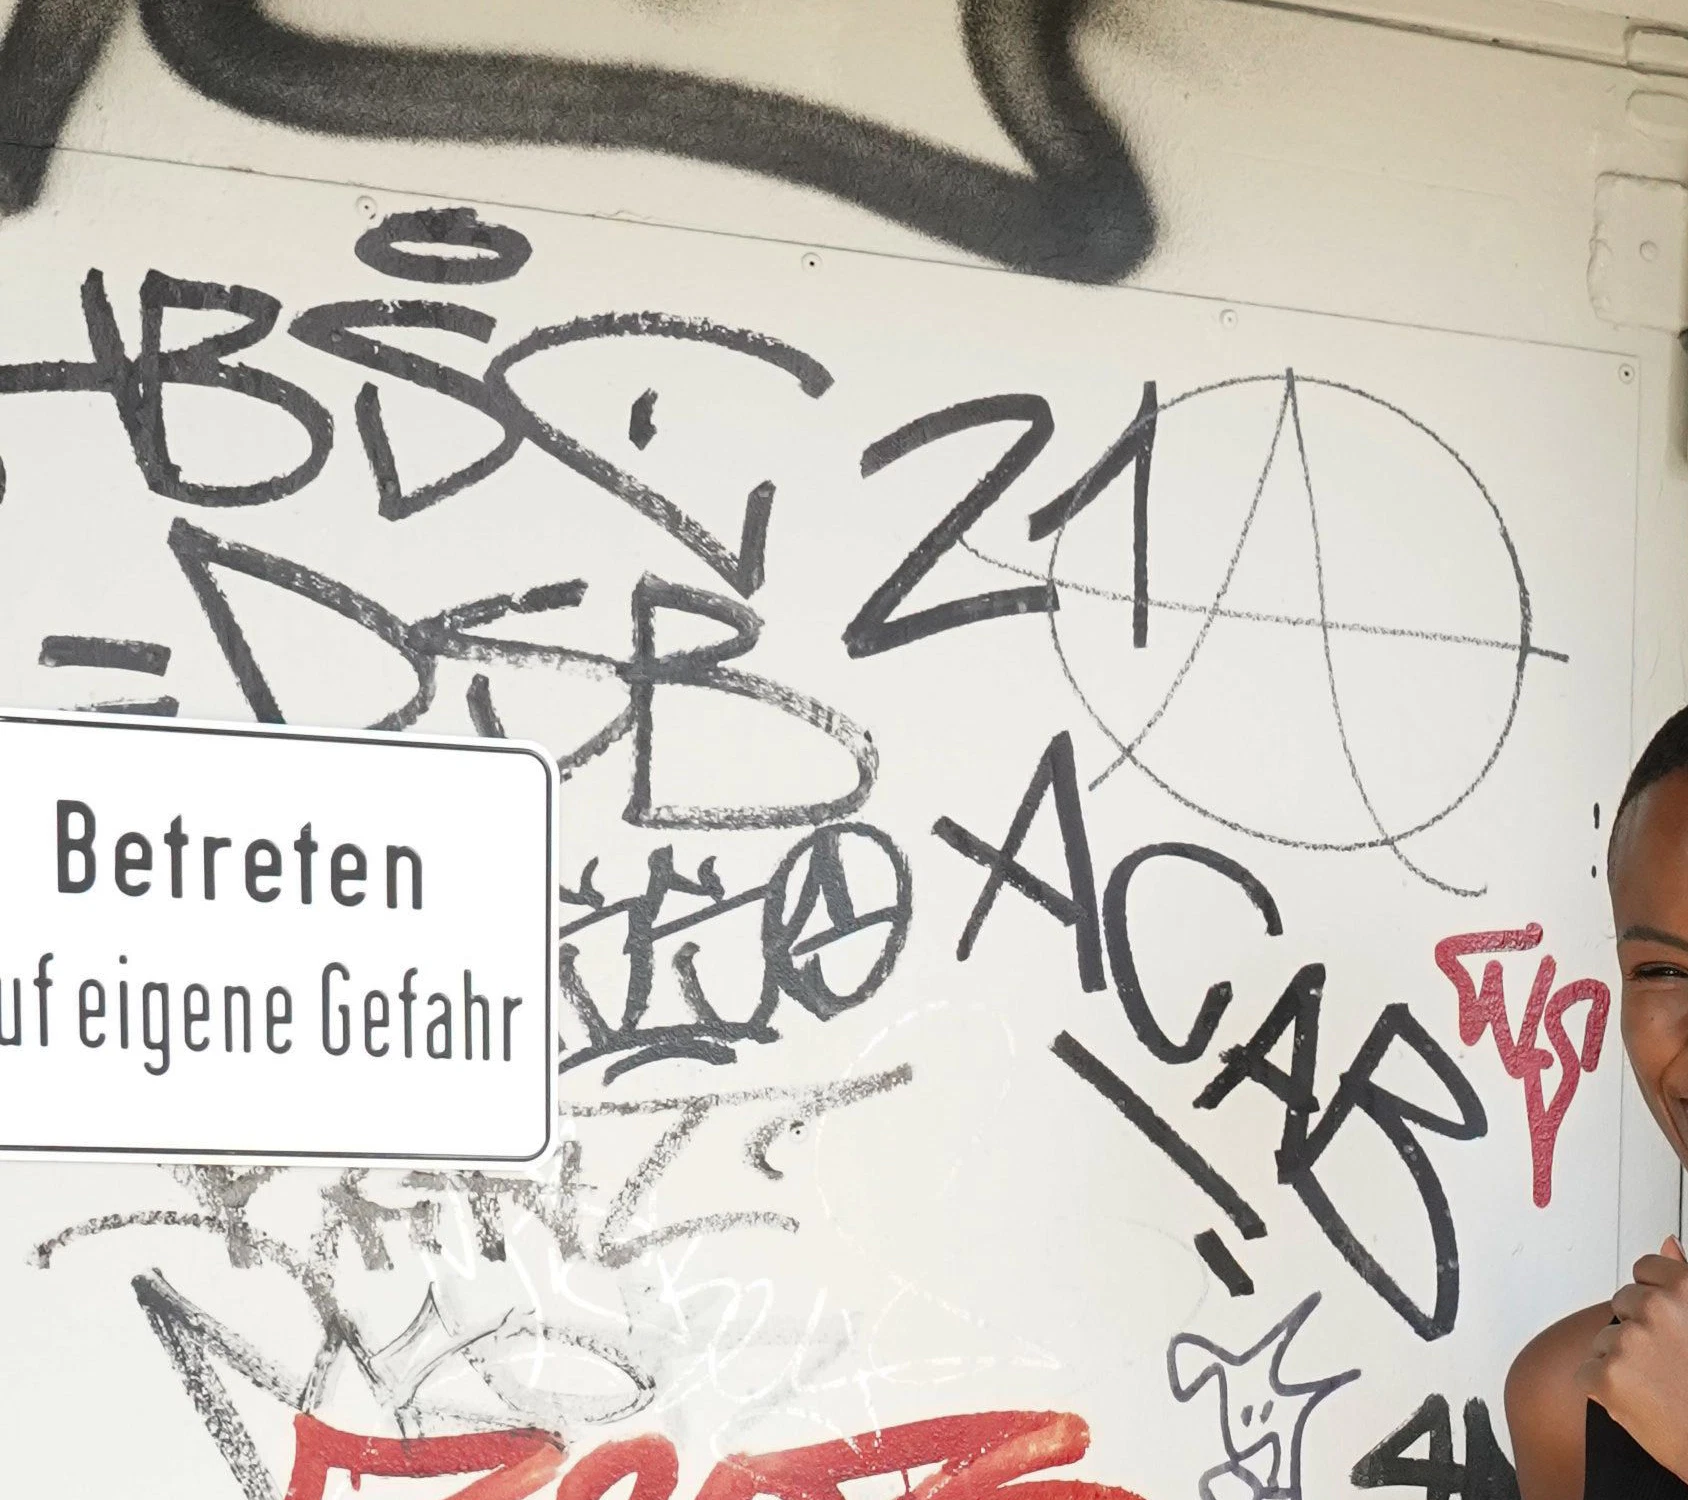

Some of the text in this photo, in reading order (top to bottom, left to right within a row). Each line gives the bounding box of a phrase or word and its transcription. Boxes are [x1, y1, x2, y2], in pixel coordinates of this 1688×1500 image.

[843, 380, 1158, 660] 21
[55, 799, 425, 911] Betreten
[78, 954, 293, 1076] eigene
[321, 961, 523, 1063] Gefahr
[931, 730, 1487, 1341] ACAB
